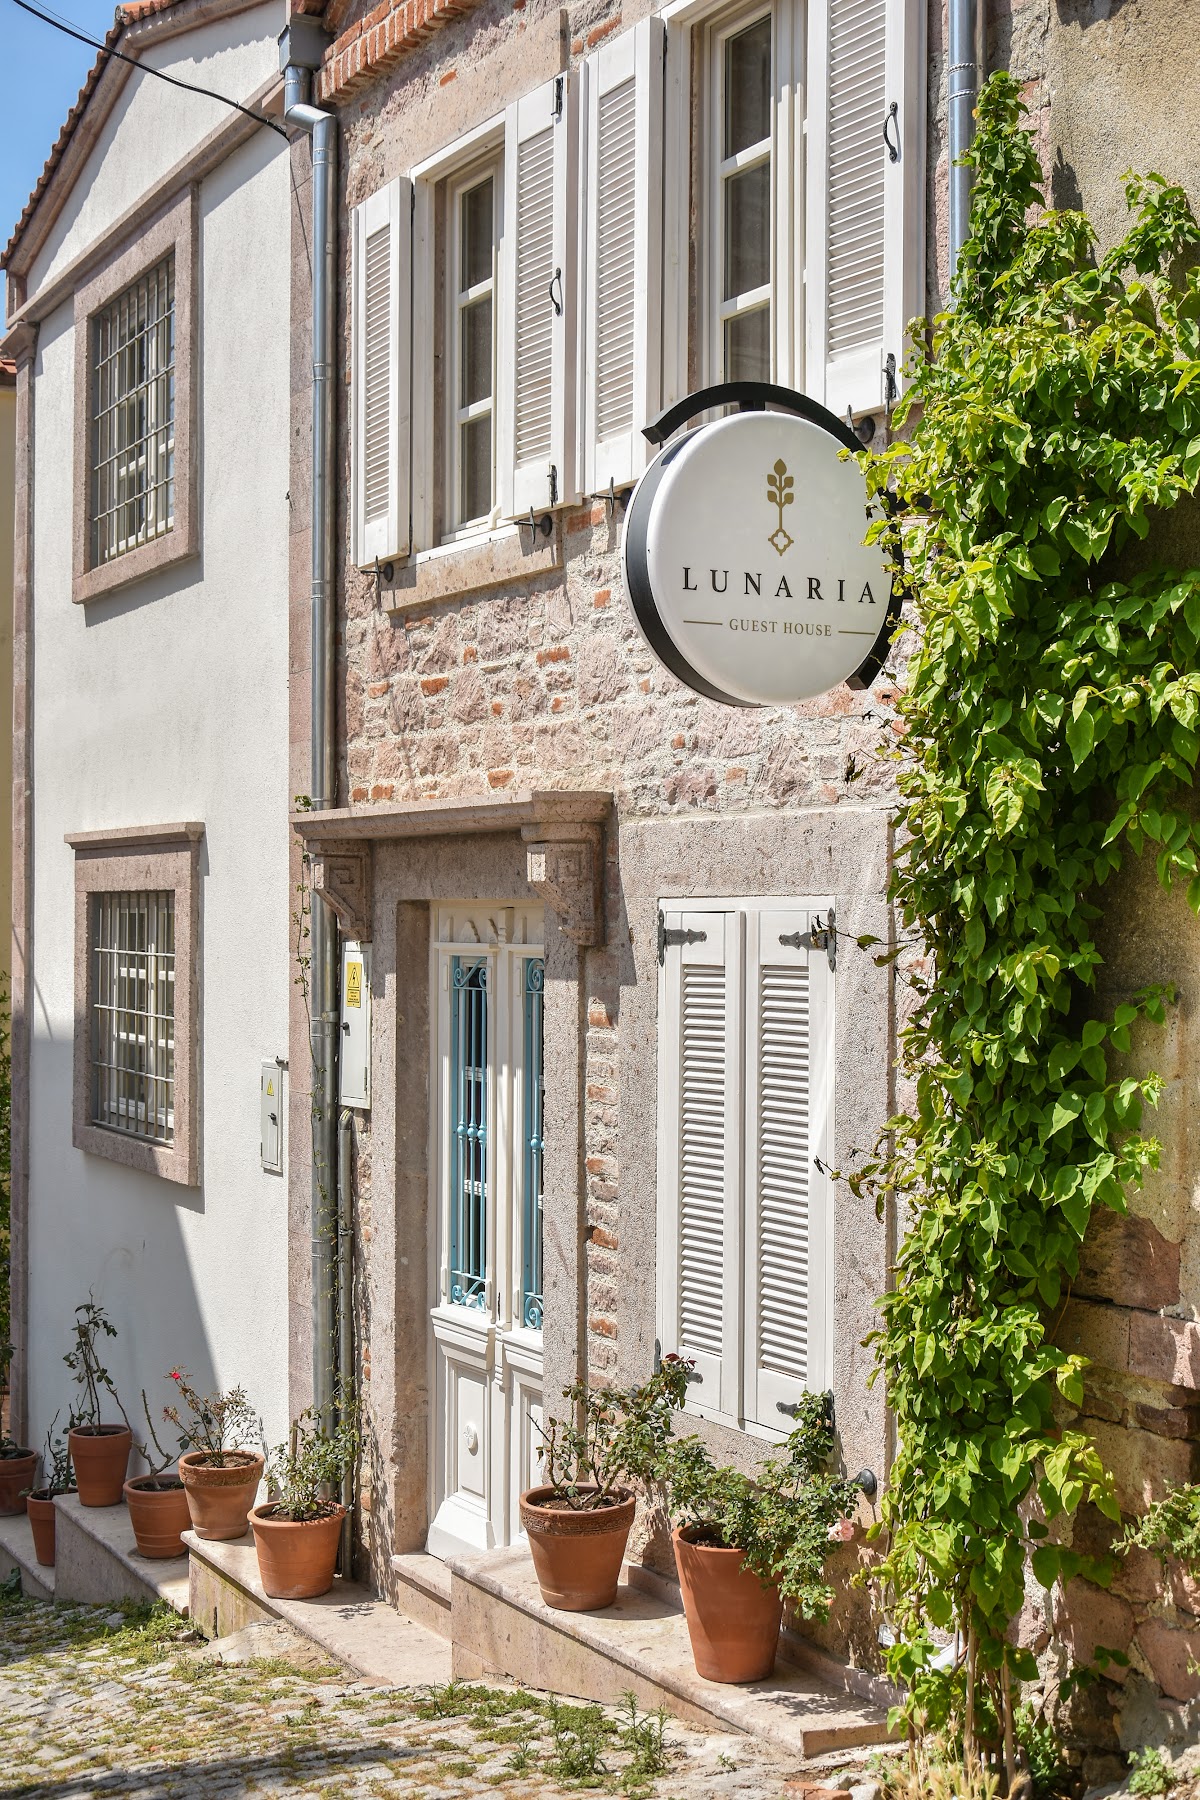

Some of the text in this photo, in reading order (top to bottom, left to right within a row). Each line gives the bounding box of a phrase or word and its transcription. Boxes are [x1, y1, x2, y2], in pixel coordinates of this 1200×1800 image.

[683, 567, 876, 604] LUNARIA
[729, 618, 832, 637] GUEST HOUSE
